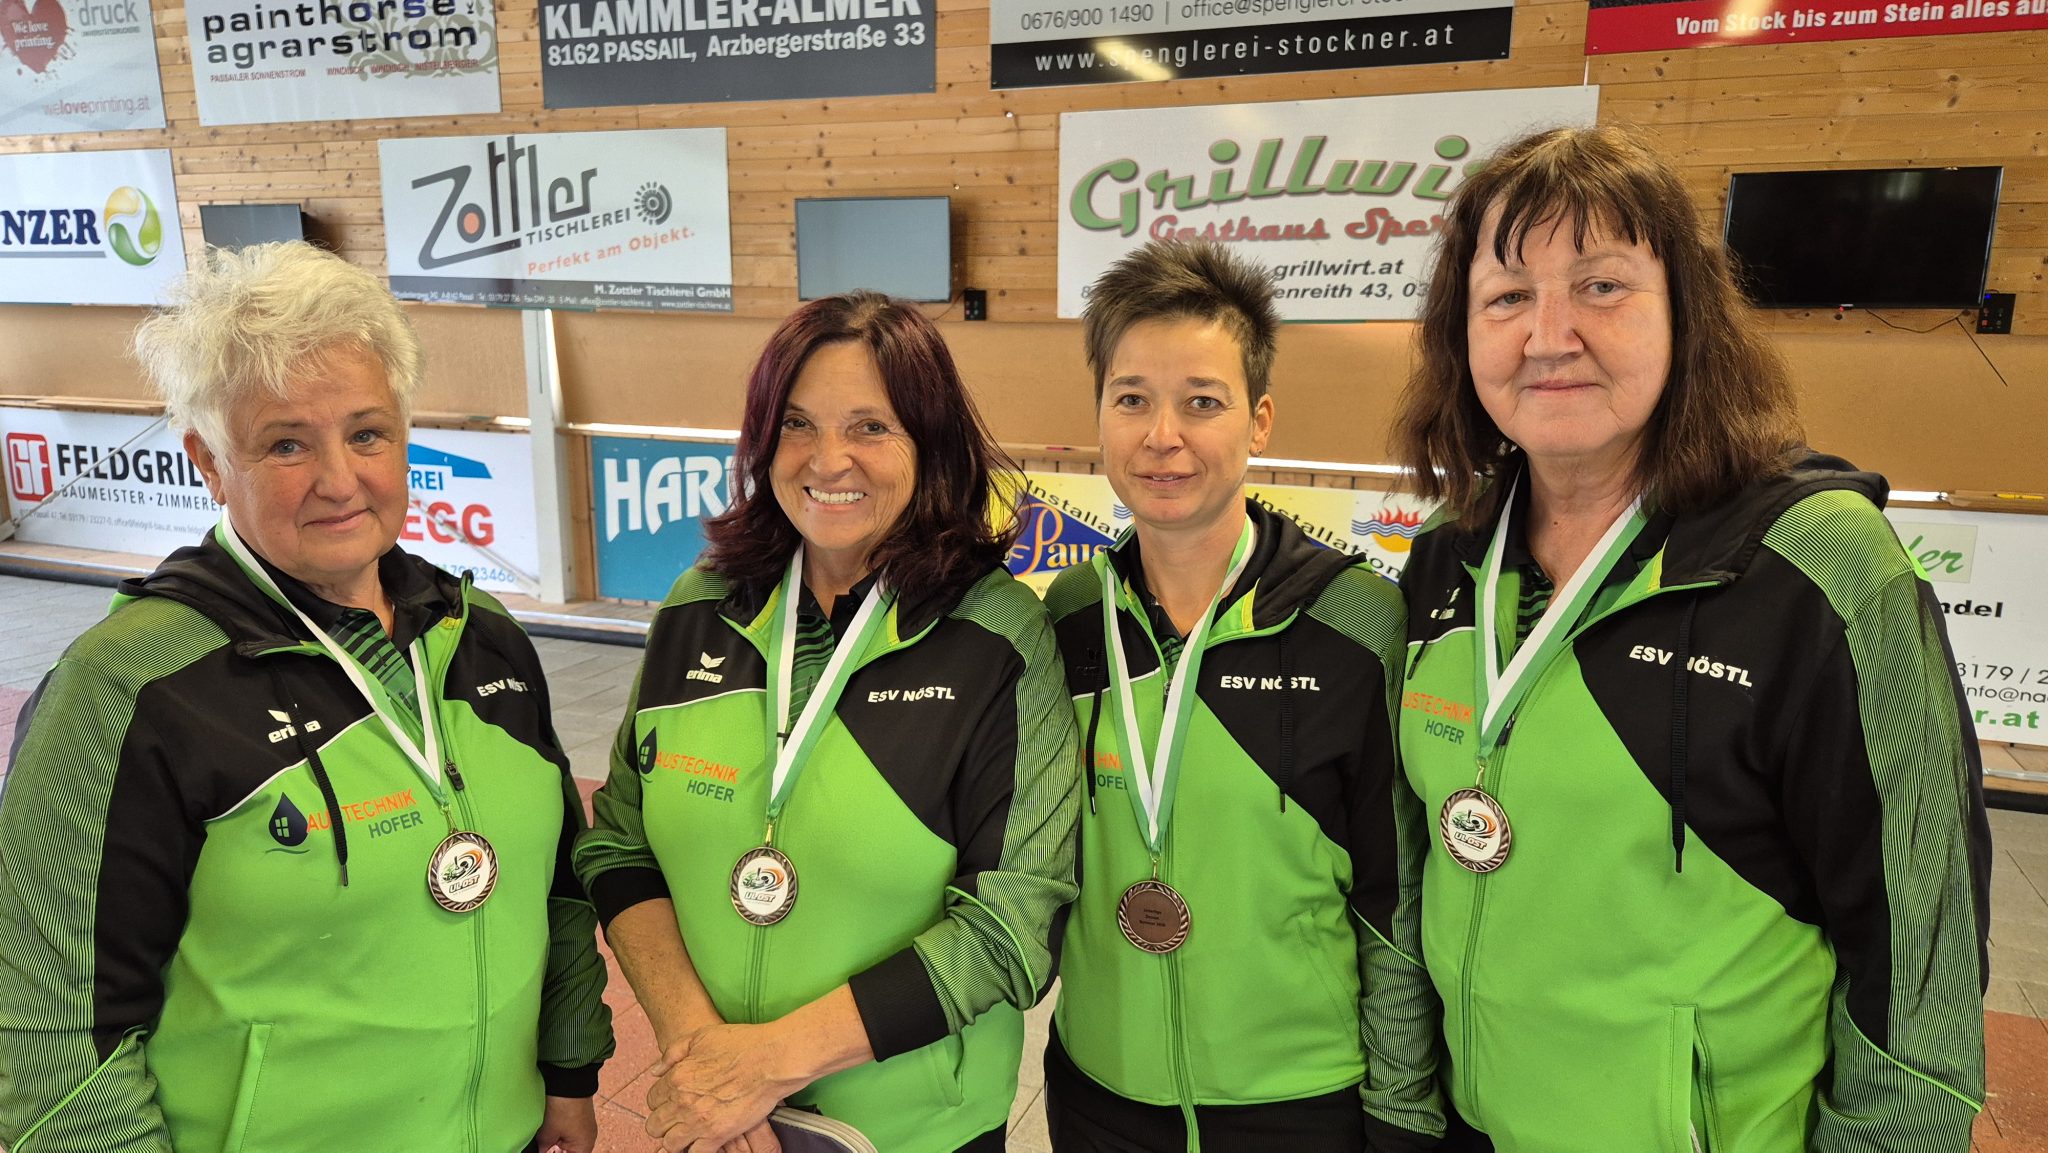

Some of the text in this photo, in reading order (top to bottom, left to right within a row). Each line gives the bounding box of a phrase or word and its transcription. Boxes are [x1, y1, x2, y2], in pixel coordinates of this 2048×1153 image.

[79, 0, 138, 26] druck
[203, 0, 456, 41] painthorse
[1021, 8, 1102, 30] 0676/900
[1110, 4, 1153, 22] 1490
[1676, 17, 1719, 35] Vom
[1725, 11, 1786, 32] Stock
[1792, 9, 1826, 28] bis
[1831, 9, 1877, 26] zum
[1884, 2, 1944, 23] Stein
[1950, 0, 2010, 19] alles
[207, 26, 477, 69] agrarstrom
[548, 22, 925, 66] 8162 PASSAIL, Arzbergerstraße 33
[1034, 24, 1454, 71] www.spenglerei-stockner.at
[43, 96, 151, 116] weloveprinting.at
[1069, 134, 1483, 237] Grillwi
[526, 207, 631, 246] TISCHLEREI
[1149, 214, 1330, 242] Gasthaus
[527, 227, 696, 276] Perfekt am Objekt.
[696, 287, 731, 298] GmbH
[1360, 284, 1393, 301] 43,
[62, 484, 223, 512] BAUMEISTER ZIMMERE
[1251, 492, 1401, 579] Intallaton
[1629, 645, 1673, 666] ESV
[476, 679, 506, 697] ESV
[686, 668, 723, 684] erima
[1220, 675, 1256, 690] ESV
[868, 686, 955, 703] ESV NÖSTL
[268, 719, 322, 743] eria
[1425, 719, 1464, 745] HOFER
[686, 779, 735, 803] HOFER
[306, 788, 417, 833] AUTECHNIK
[368, 811, 423, 839] HOFER
